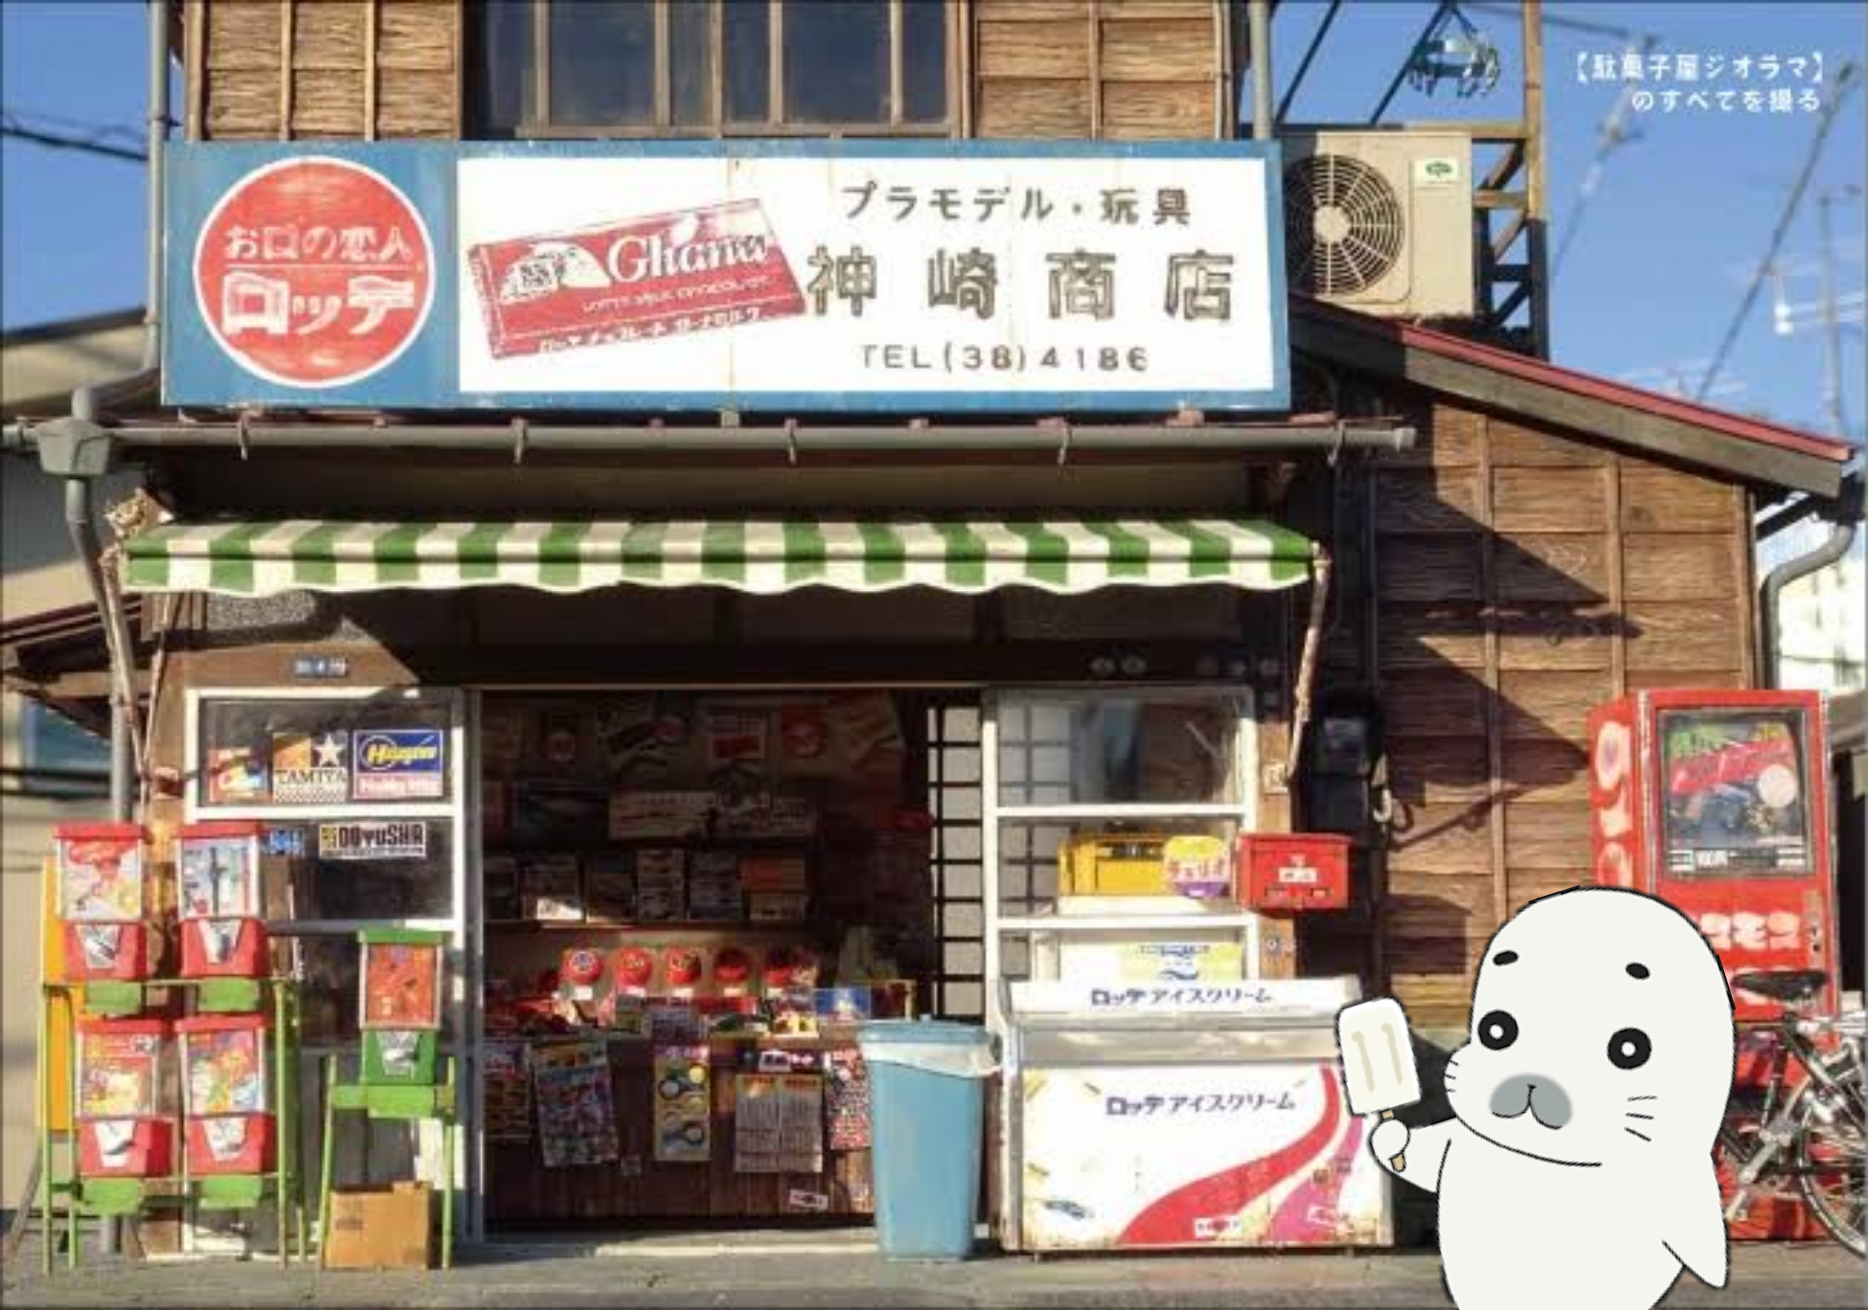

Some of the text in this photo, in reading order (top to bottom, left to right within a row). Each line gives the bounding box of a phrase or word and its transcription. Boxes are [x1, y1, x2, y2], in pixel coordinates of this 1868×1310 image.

[843, 181, 1191, 226] プラモデル・玩具
[224, 225, 413, 261] お口の恋人
[607, 230, 769, 283] Ghana
[221, 271, 415, 336] ロッテ
[275, 769, 347, 785] TAMIYA
[1091, 988, 1147, 1006] ロッテ
[1105, 1091, 1297, 1116] ロッテ アイスクリーム
